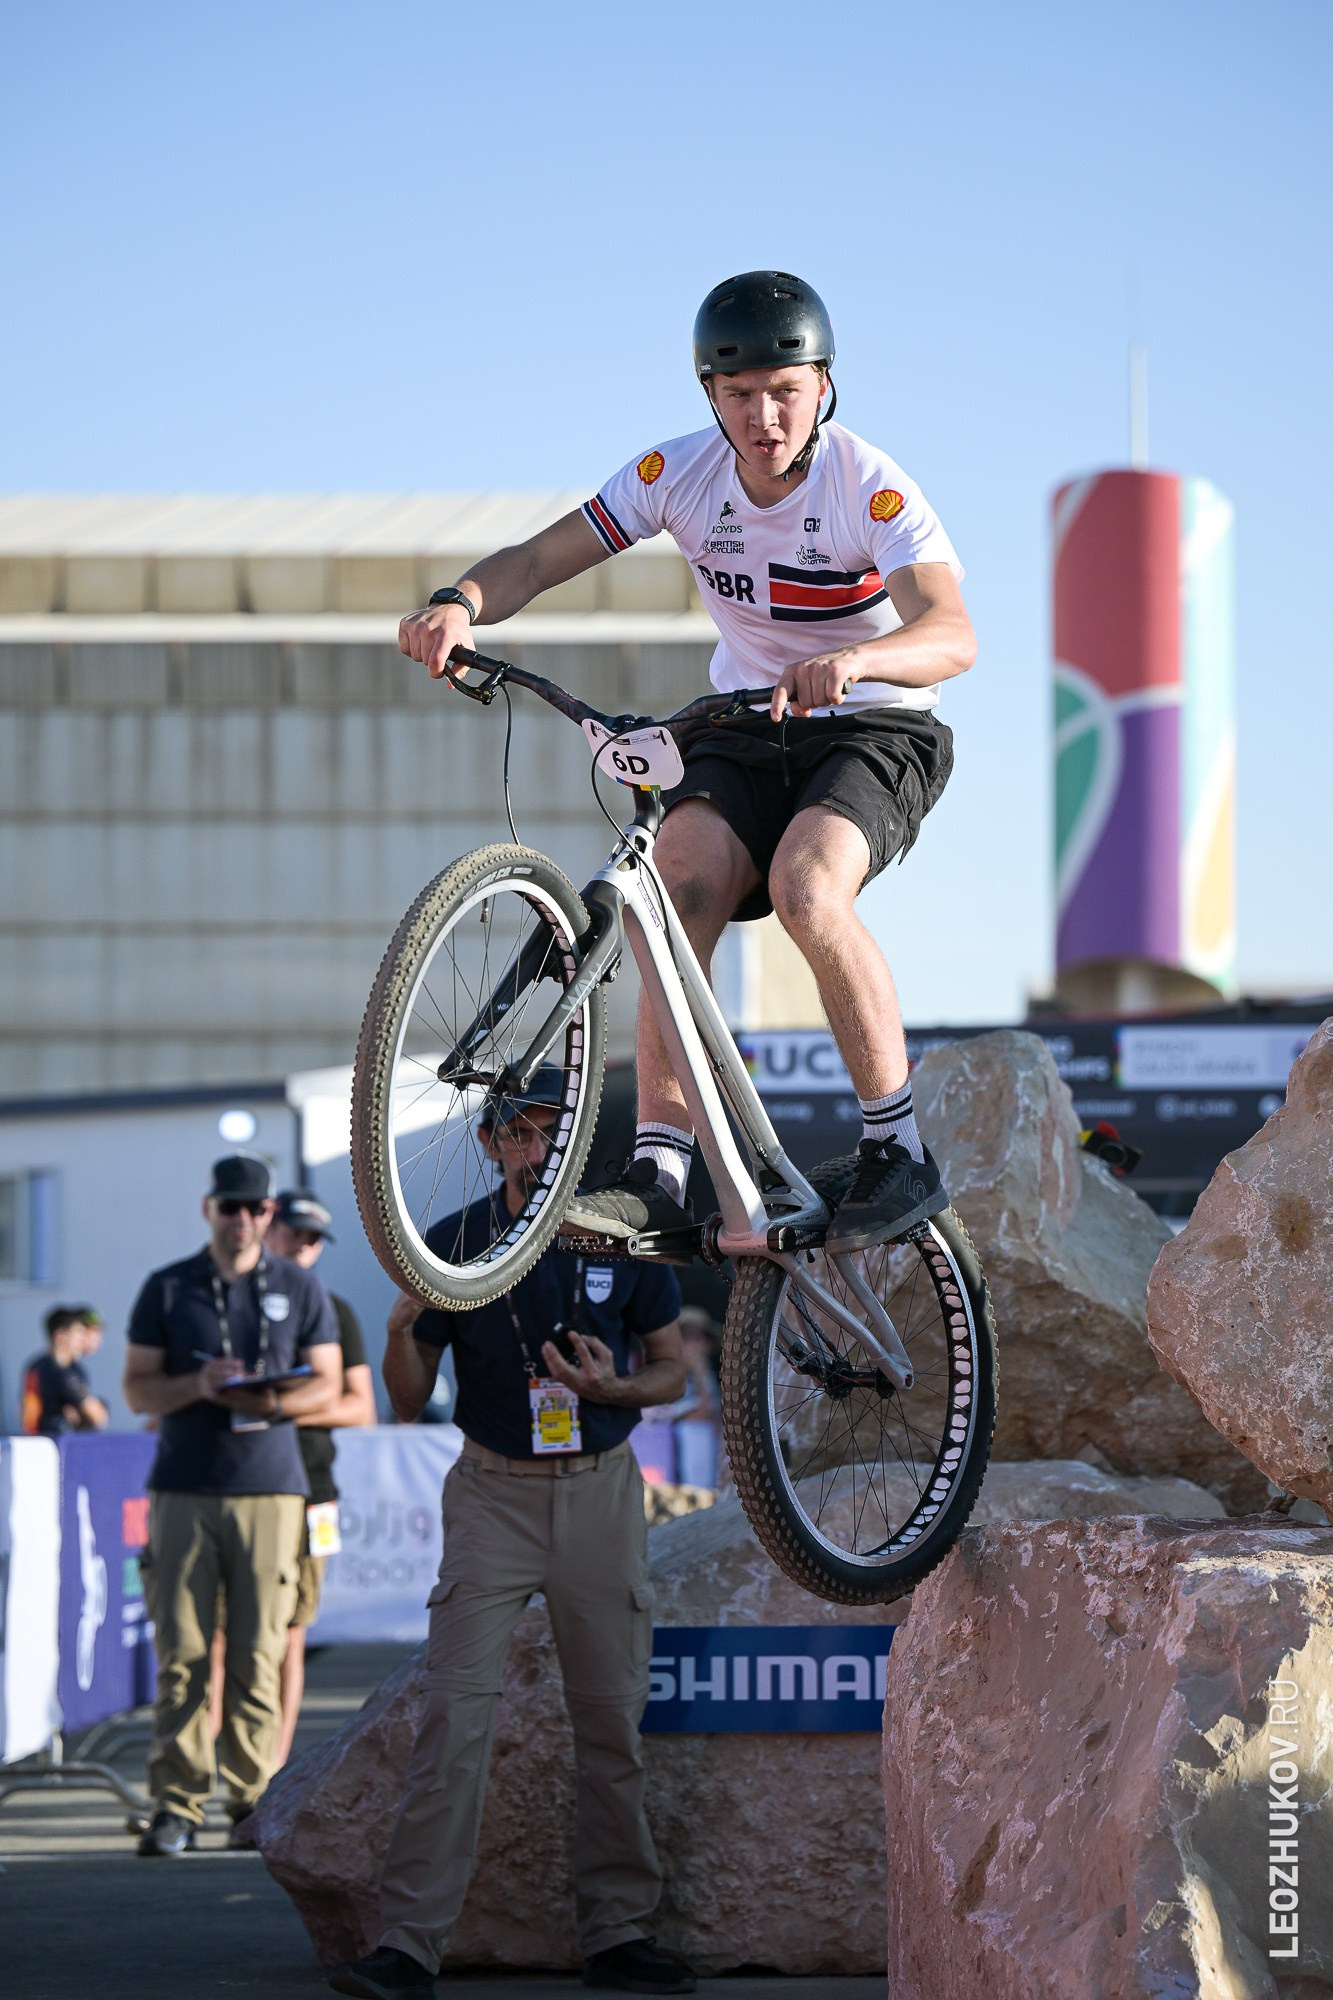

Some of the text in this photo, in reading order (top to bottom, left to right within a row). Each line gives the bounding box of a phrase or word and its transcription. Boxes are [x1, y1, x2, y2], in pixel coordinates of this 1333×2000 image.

[710, 540, 744, 548] BRITISH
[697, 564, 756, 605] GBR
[612, 751, 650, 775] 6D
[762, 1045, 849, 1078] UC
[648, 1655, 888, 1701] SHIMA
